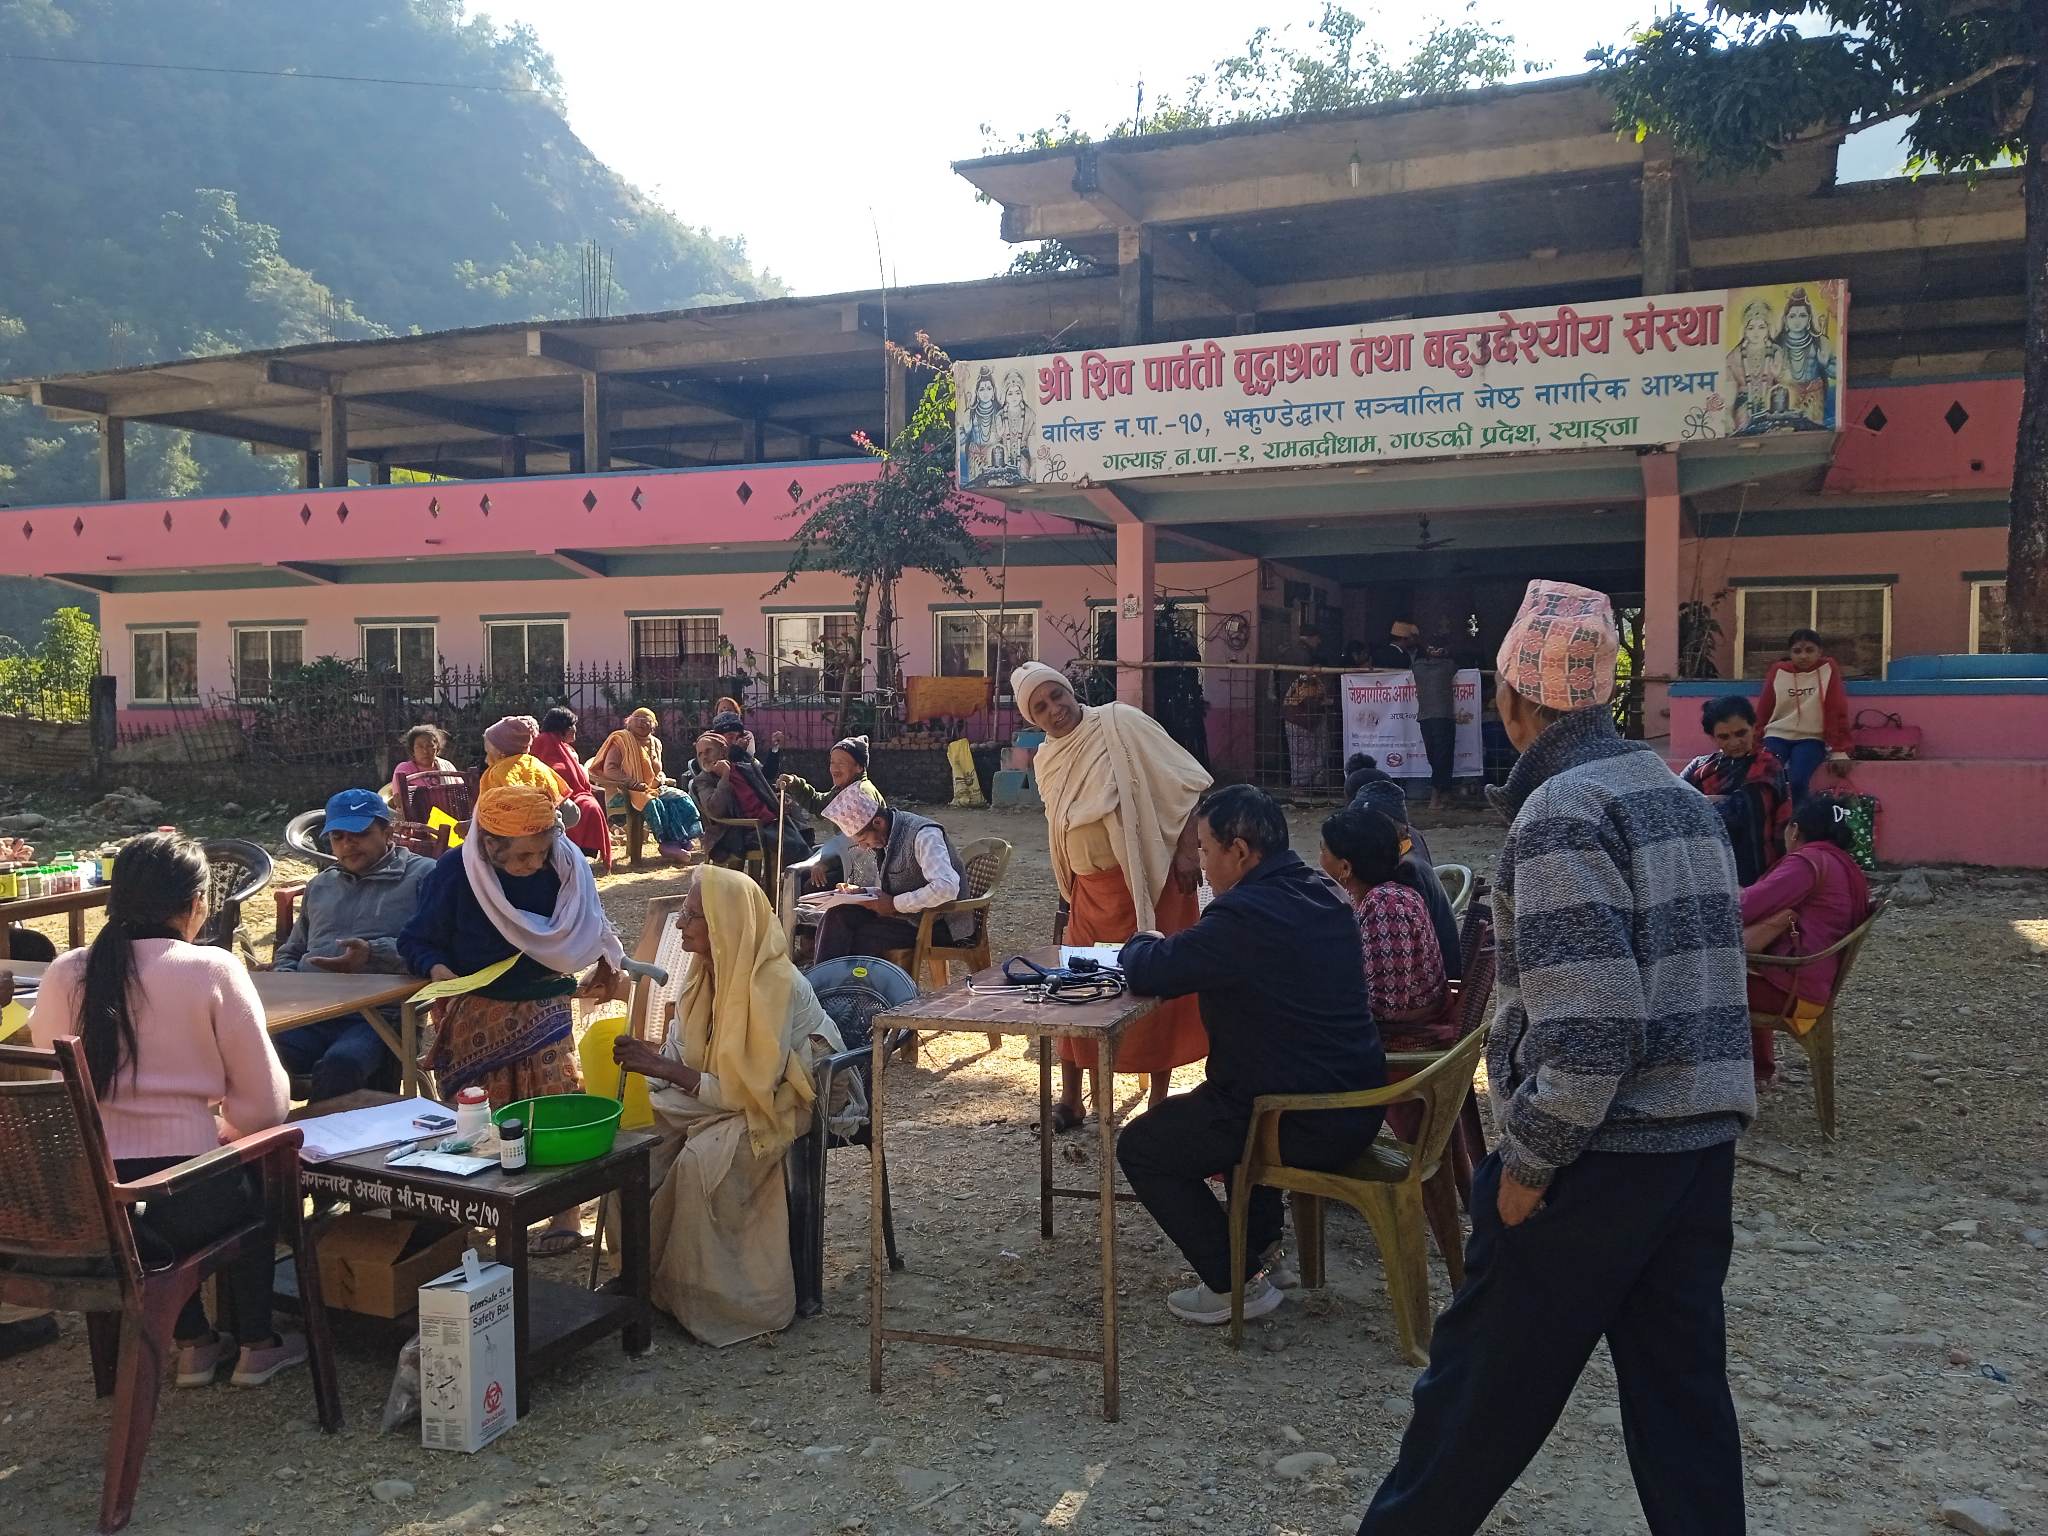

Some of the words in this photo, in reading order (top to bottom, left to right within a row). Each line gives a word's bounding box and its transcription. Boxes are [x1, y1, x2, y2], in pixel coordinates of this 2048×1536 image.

[1038, 355, 1073, 405] श्री
[1081, 351, 1135, 401] शिव
[1143, 340, 1226, 393] पार्वती
[1350, 333, 1414, 377] तथा
[1423, 305, 1614, 379] बहुउद्देश्यीय
[1622, 302, 1724, 355] संस्था
[1042, 415, 1106, 443] वालिङ
[1354, 385, 1464, 420] सञ्चालित
[1474, 383, 1524, 409] जेष्ठ
[1535, 373, 1630, 406] नागरिक
[1641, 371, 1719, 396] आश्रम
[1389, 421, 1473, 450] गण्डकी
[354, 1179, 393, 1206] अर्याल
[473, 1310, 495, 1328] Safety
